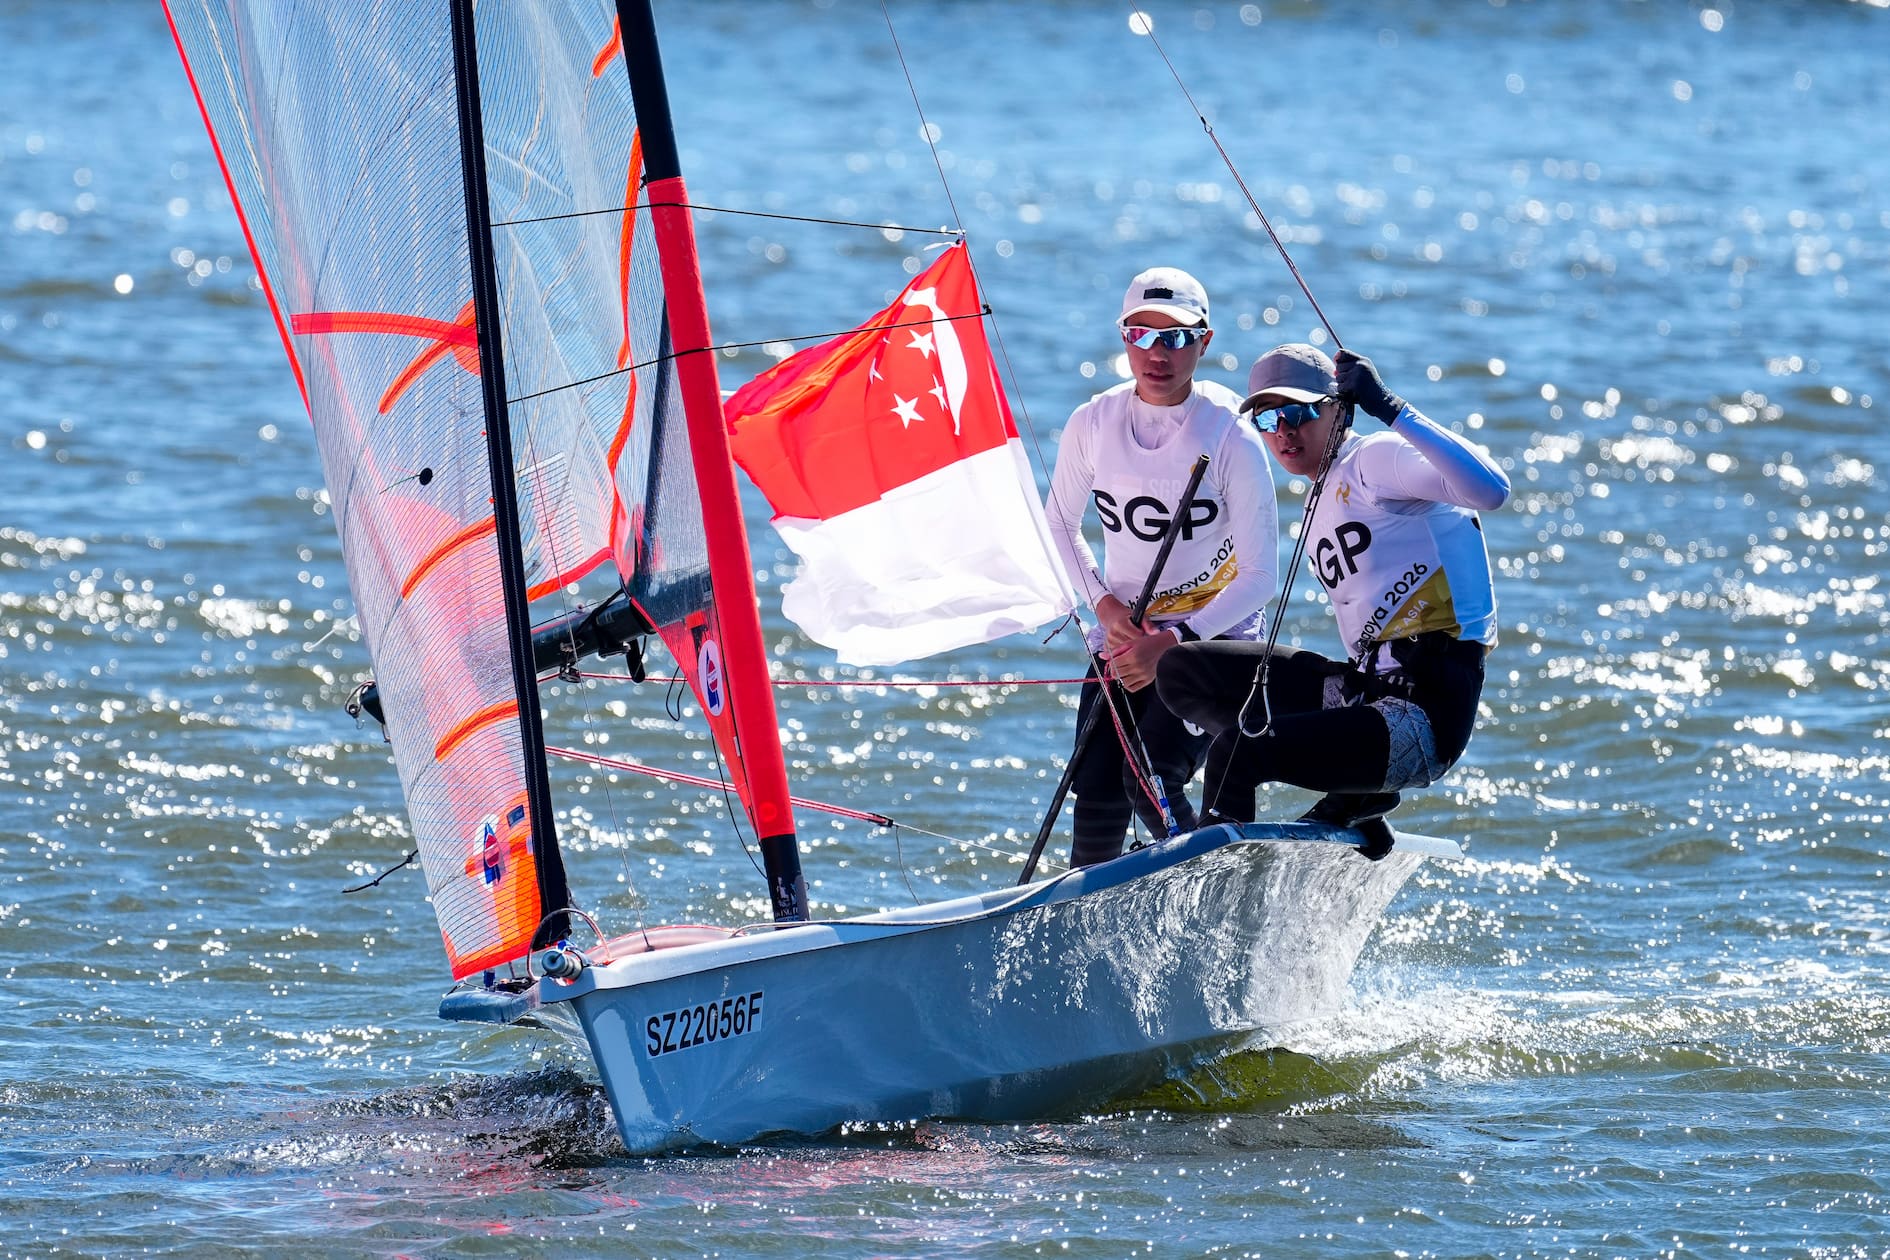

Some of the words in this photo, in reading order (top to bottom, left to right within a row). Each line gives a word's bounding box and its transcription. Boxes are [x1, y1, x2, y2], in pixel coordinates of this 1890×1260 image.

[1092, 489, 1219, 542] SGP
[1210, 534, 1234, 571] 202
[1309, 521, 1372, 593] GP
[1384, 562, 1428, 606] 2026
[1403, 599, 1429, 626] ASIA
[647, 991, 763, 1057] SZ22056F
